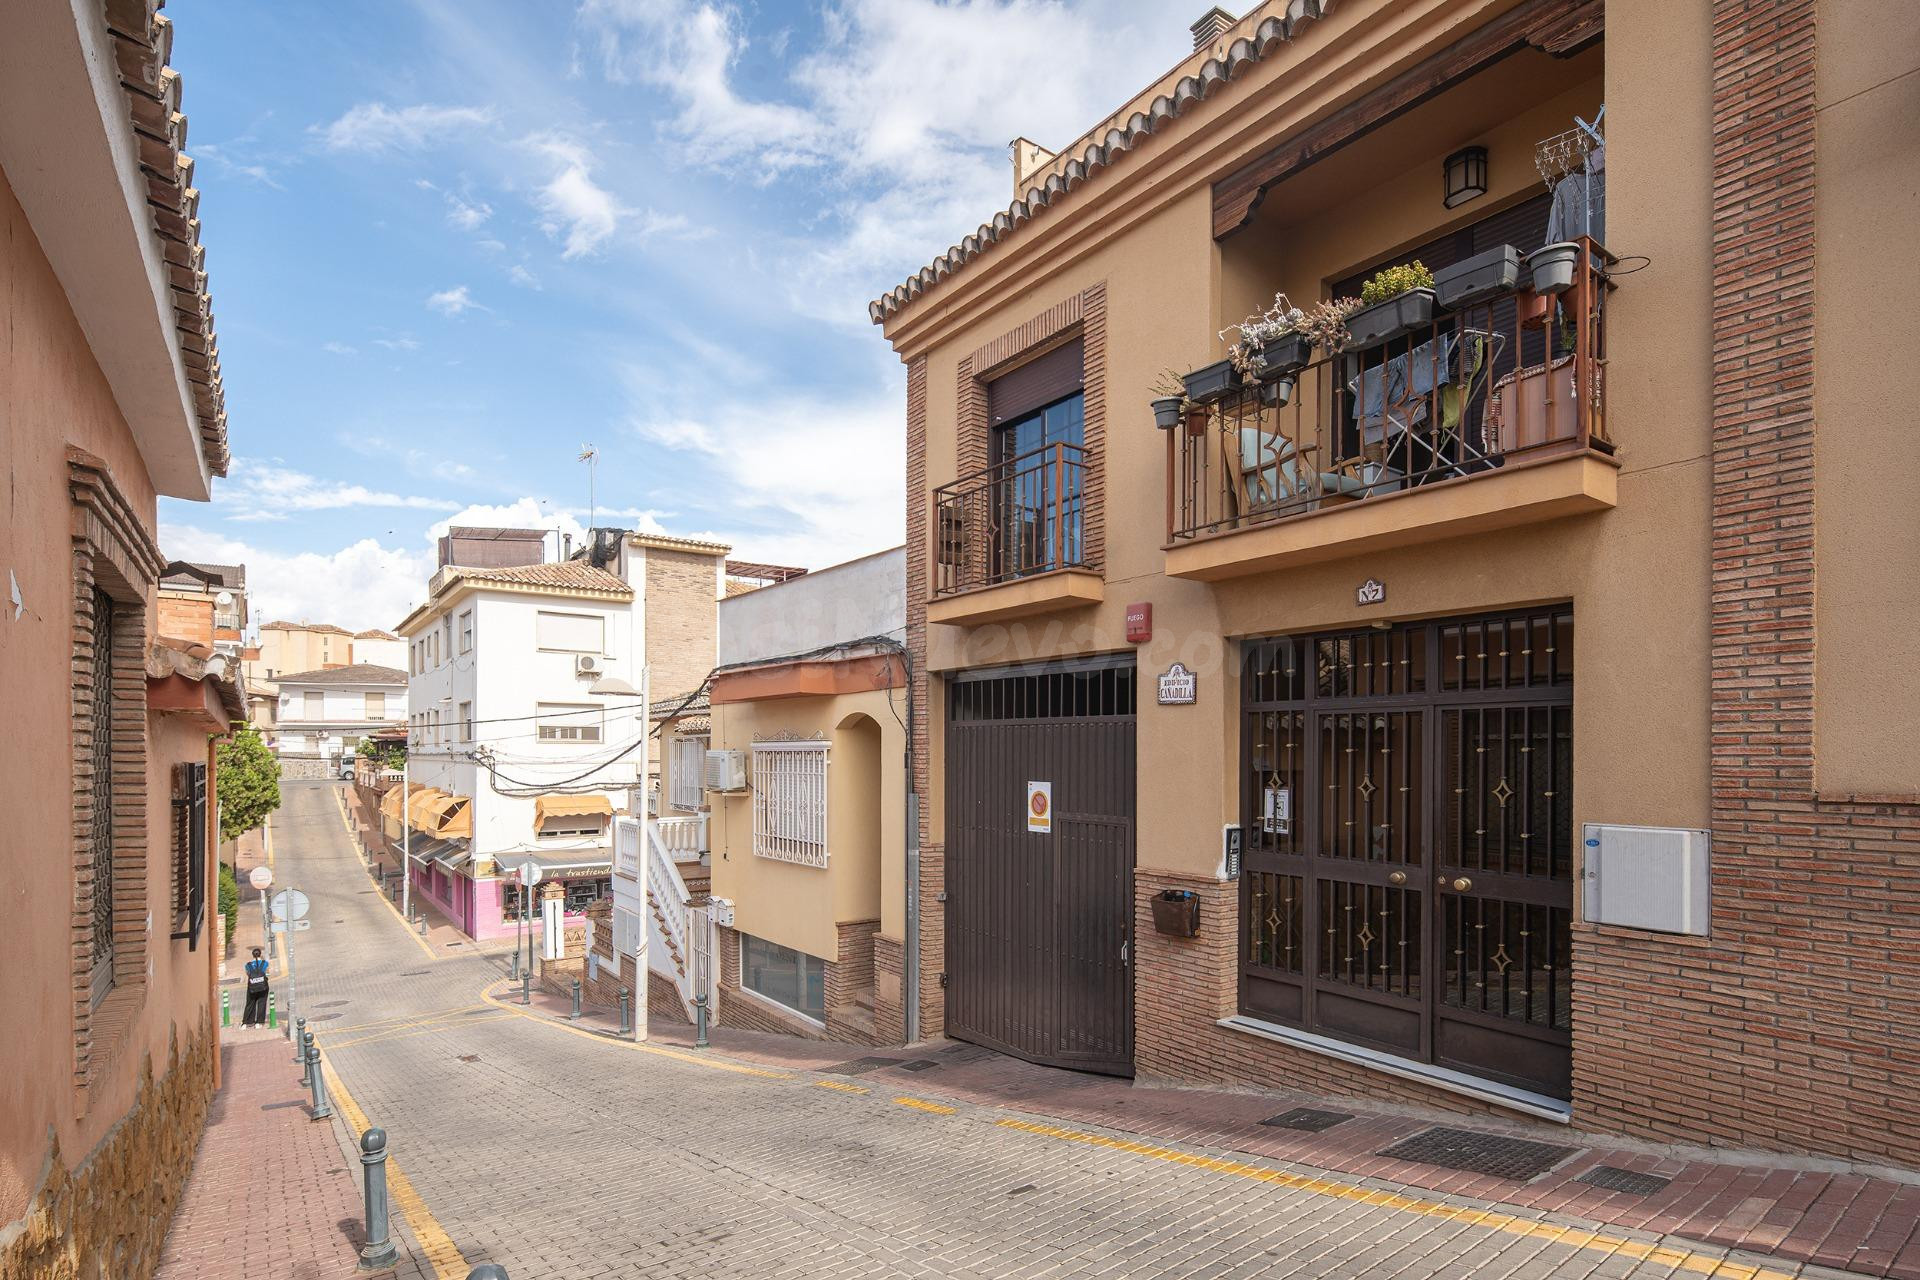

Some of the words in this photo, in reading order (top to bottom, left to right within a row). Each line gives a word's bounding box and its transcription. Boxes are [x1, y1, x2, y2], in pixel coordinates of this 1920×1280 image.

[1127, 613, 1144, 622] FUEGO
[550, 870, 560, 878] la
[566, 866, 612, 877] trastiend
